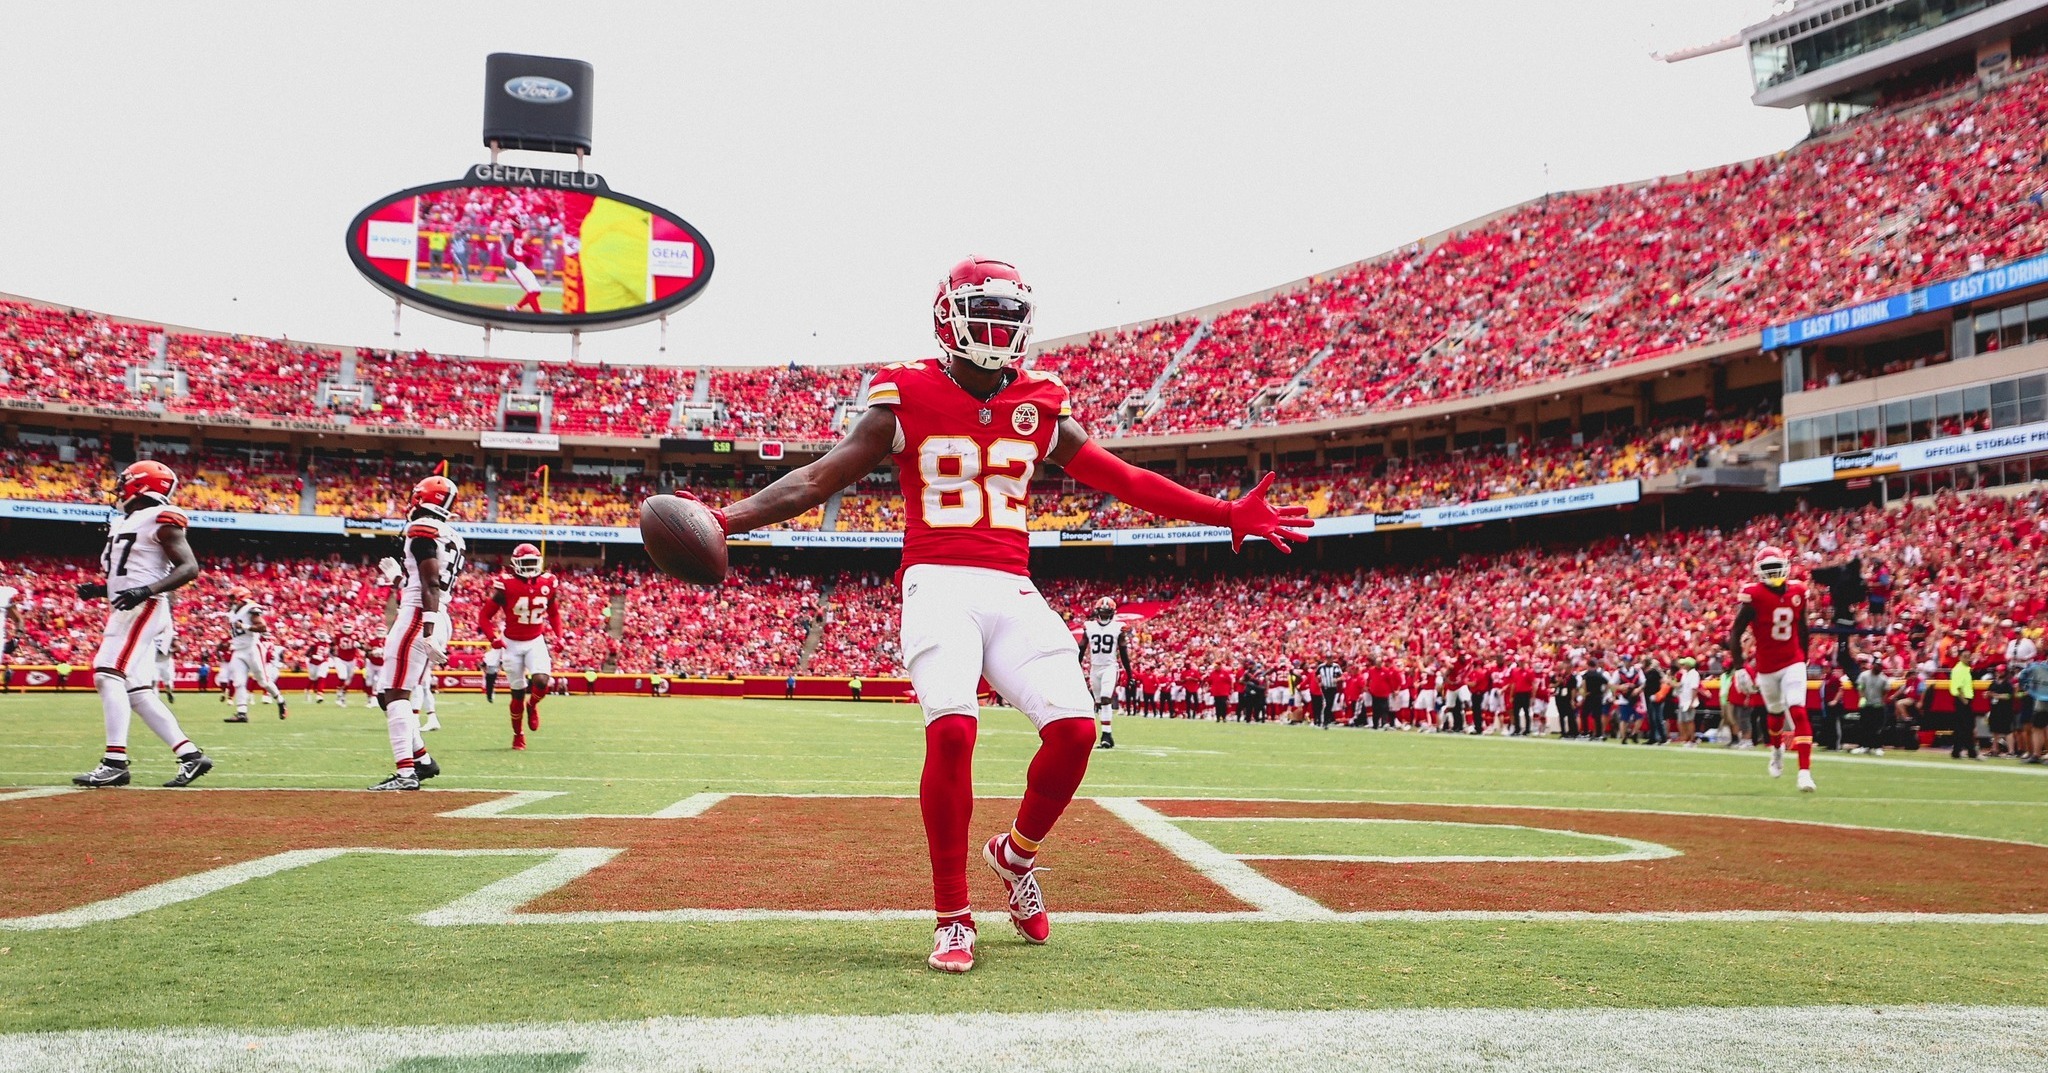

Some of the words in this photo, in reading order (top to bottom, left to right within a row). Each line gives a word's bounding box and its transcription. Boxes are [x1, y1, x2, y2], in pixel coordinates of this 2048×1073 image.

[517, 79, 559, 99] Ford
[475, 164, 536, 184] GEHA
[540, 169, 600, 190] FIELD
[652, 246, 689, 259] GEHA
[1950, 273, 1985, 301] EASY
[1987, 269, 2006, 290] TO
[1802, 314, 1833, 339] EASY
[1833, 310, 1849, 330] TO
[1852, 299, 1890, 326] DRINK
[94, 408, 161, 420] RICHARDSON
[209, 415, 251, 425] CARSON
[293, 421, 347, 432] GONZALEZ
[388, 427, 426, 436] WATERS
[1925, 444, 1971, 458] OFFICIAL
[1976, 433, 2026, 450] STORAGE
[918, 435, 1038, 532] 82
[12, 504, 58, 514] OFFICIAL
[62, 507, 109, 517] STORAGE
[1438, 510, 1469, 520] OFFICIAL
[1471, 505, 1502, 516] STORAGE
[1504, 501, 1539, 512] PROVIDER
[1541, 499, 1550, 507] OF
[1553, 497, 1566, 505] THE
[1569, 493, 1595, 503] CHIEFS
[202, 514, 236, 524] CHIEFS
[470, 526, 509, 534] STORAGE
[512, 528, 554, 536] PROVIDER
[791, 535, 828, 543] OFFICIAL
[1131, 532, 1165, 540] OFFICIAL
[1167, 531, 1201, 539] STORAGE
[1203, 529, 1231, 537] PROVID
[512, 596, 549, 625] 42
[1771, 606, 1794, 641] 8
[1091, 634, 1114, 654] 39
